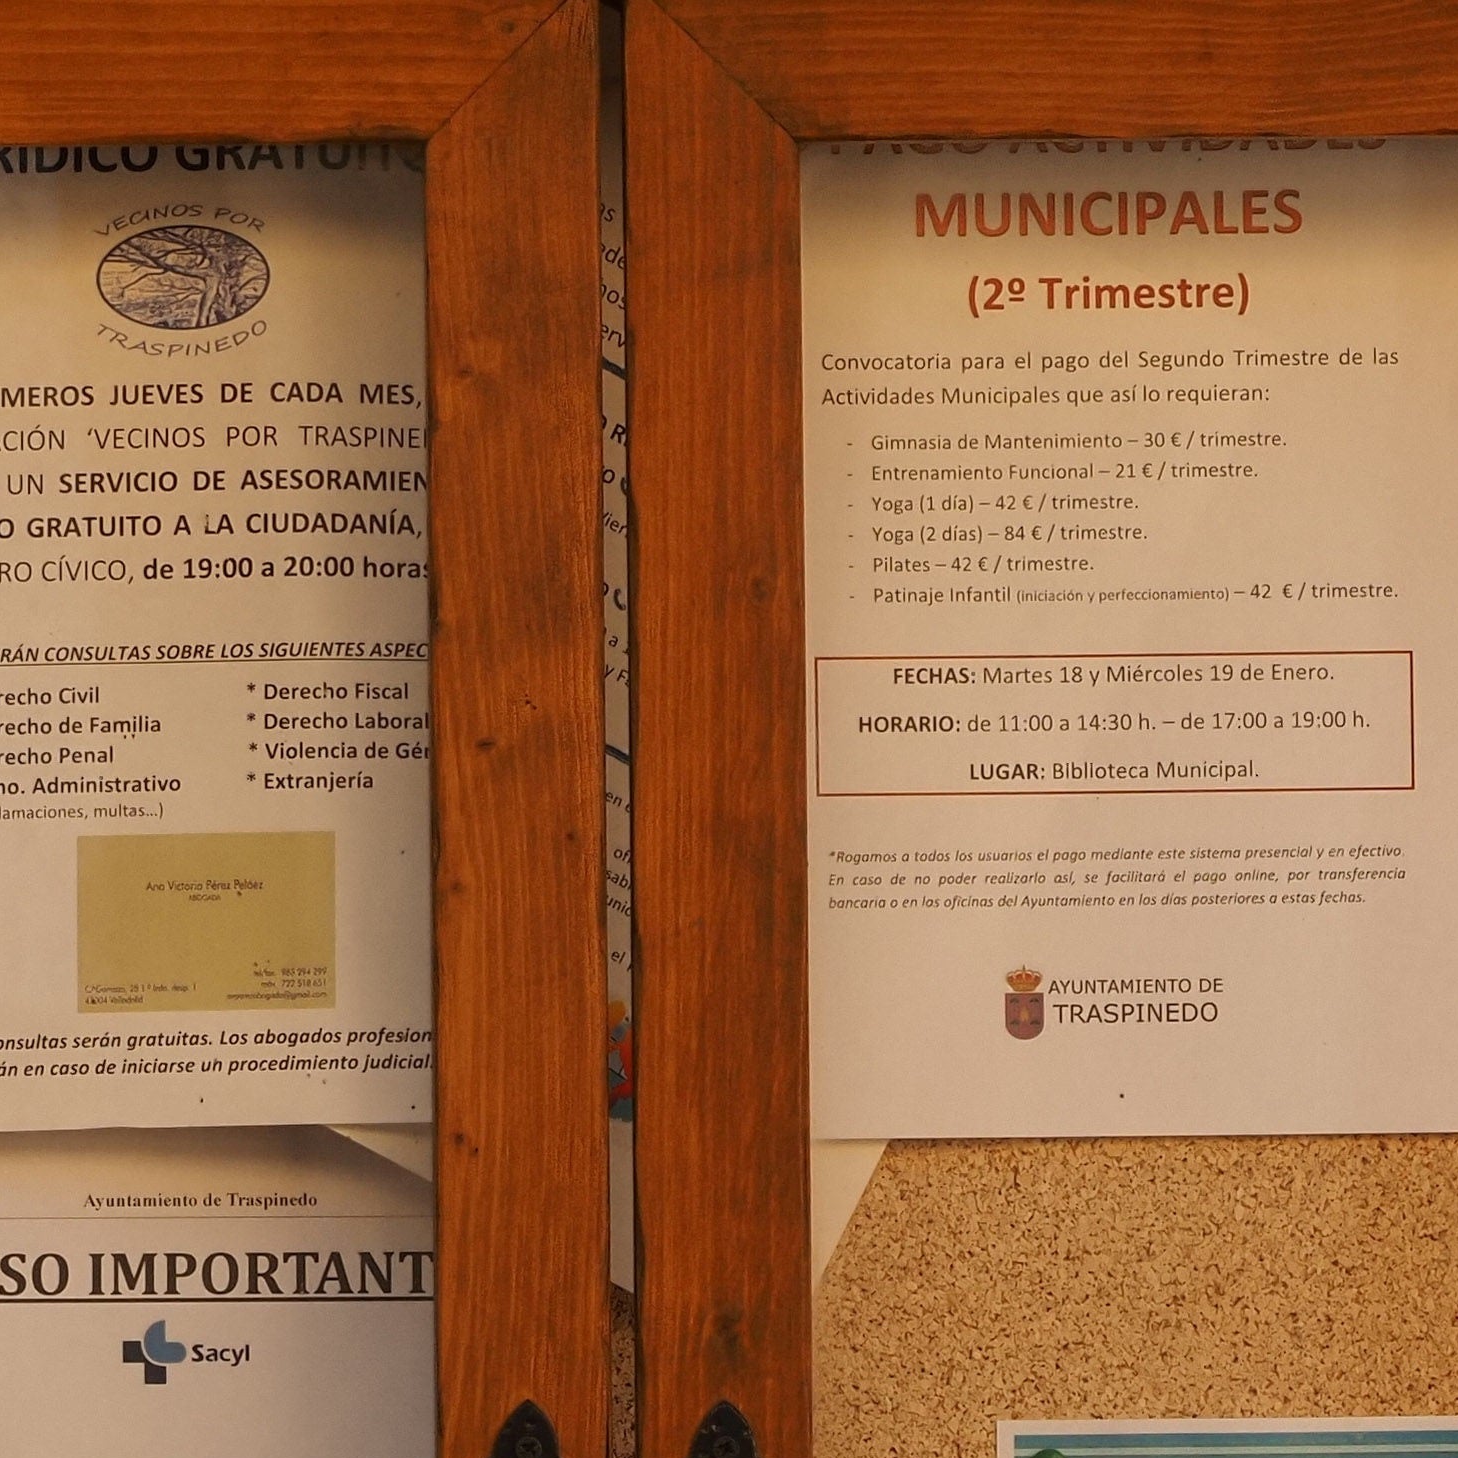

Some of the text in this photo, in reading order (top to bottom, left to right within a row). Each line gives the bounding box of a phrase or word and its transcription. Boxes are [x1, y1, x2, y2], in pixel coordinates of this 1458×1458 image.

[916, 189, 1302, 237] MUNICIPALES
[969, 273, 1249, 318] (2º Trimestre)
[110, 384, 203, 406] JUEVES
[221, 384, 253, 403] DE
[270, 383, 343, 403] CADA
[360, 384, 421, 408] MES,
[970, 760, 1258, 781] LUGAR: Biblioteca Municipal.
[94, 802, 163, 819] multas...)
[1048, 978, 1223, 994] AYUNTAMIENTO DE
[1053, 1002, 1218, 1023] TRASPINEDO
[89, 1252, 432, 1295] IMPORTANT
[191, 1344, 250, 1366] Sacyl
